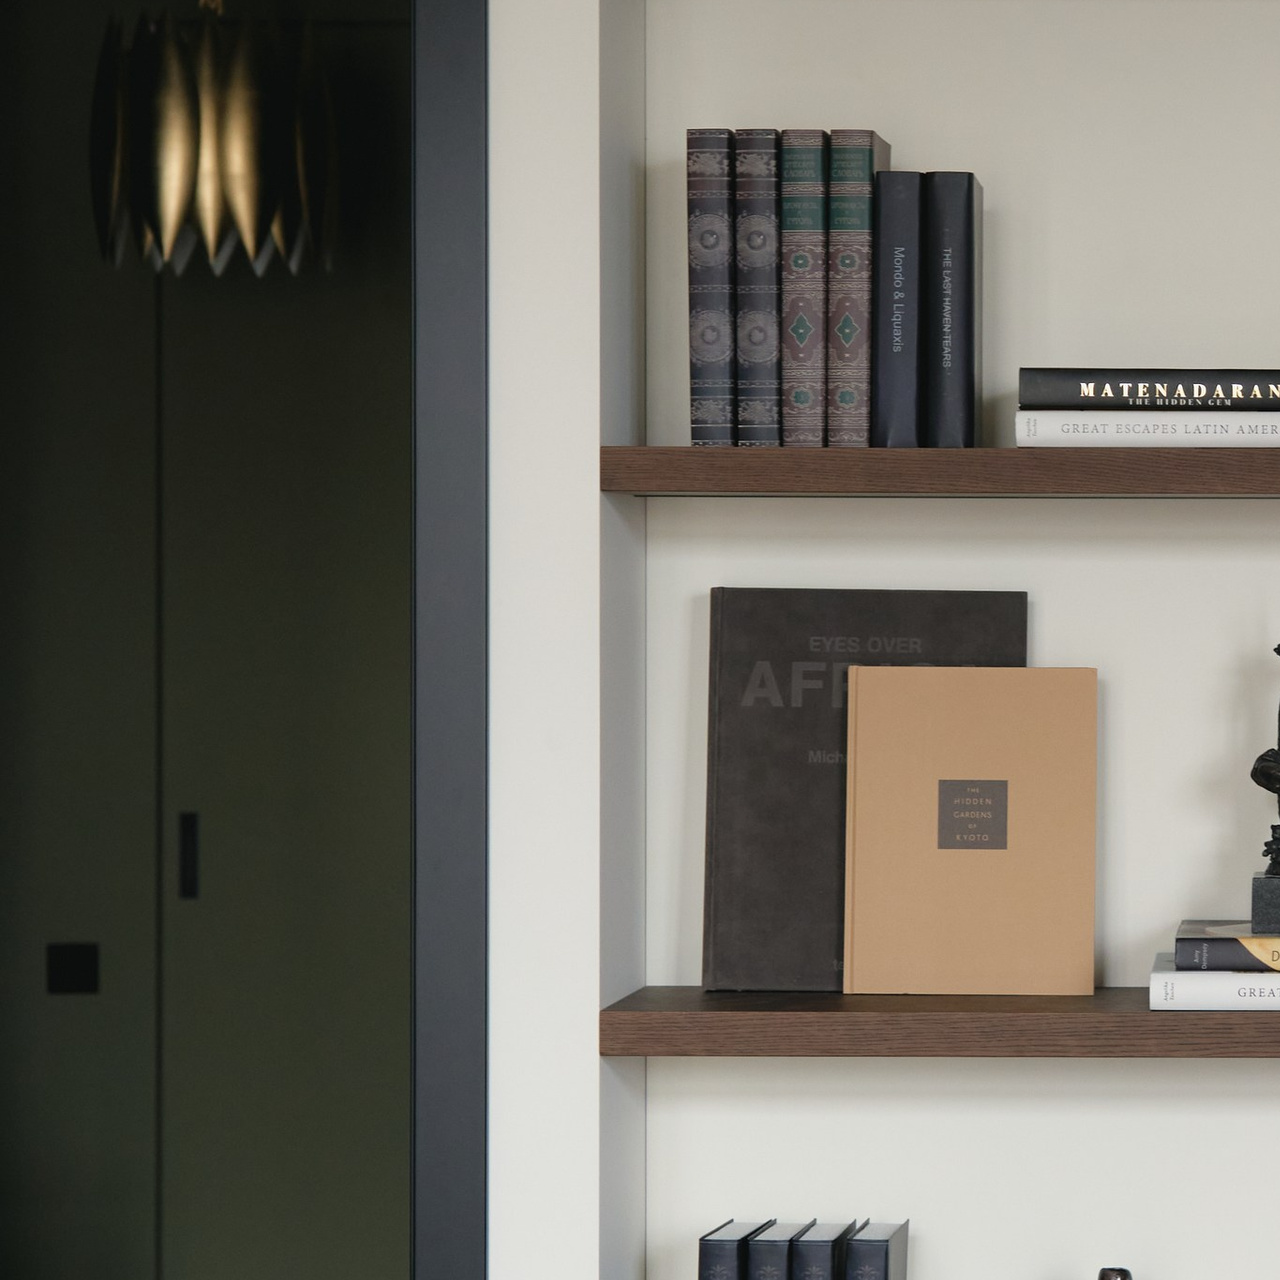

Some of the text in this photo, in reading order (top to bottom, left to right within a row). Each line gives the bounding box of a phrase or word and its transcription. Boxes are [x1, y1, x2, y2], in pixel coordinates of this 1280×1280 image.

[891, 247, 905, 353] Mondo & Liquaxis
[942, 247, 952, 368] THE LAST HAVEN TEARS
[1157, 398, 1202, 406] HIDDEN
[1208, 398, 1231, 407] GEM
[1061, 423, 1109, 434] GREAT
[1116, 423, 1177, 434] ESCAPES
[1184, 423, 1229, 435] LATIN
[809, 636, 923, 654] EYES OVER
[953, 811, 992, 819] GARDENS
